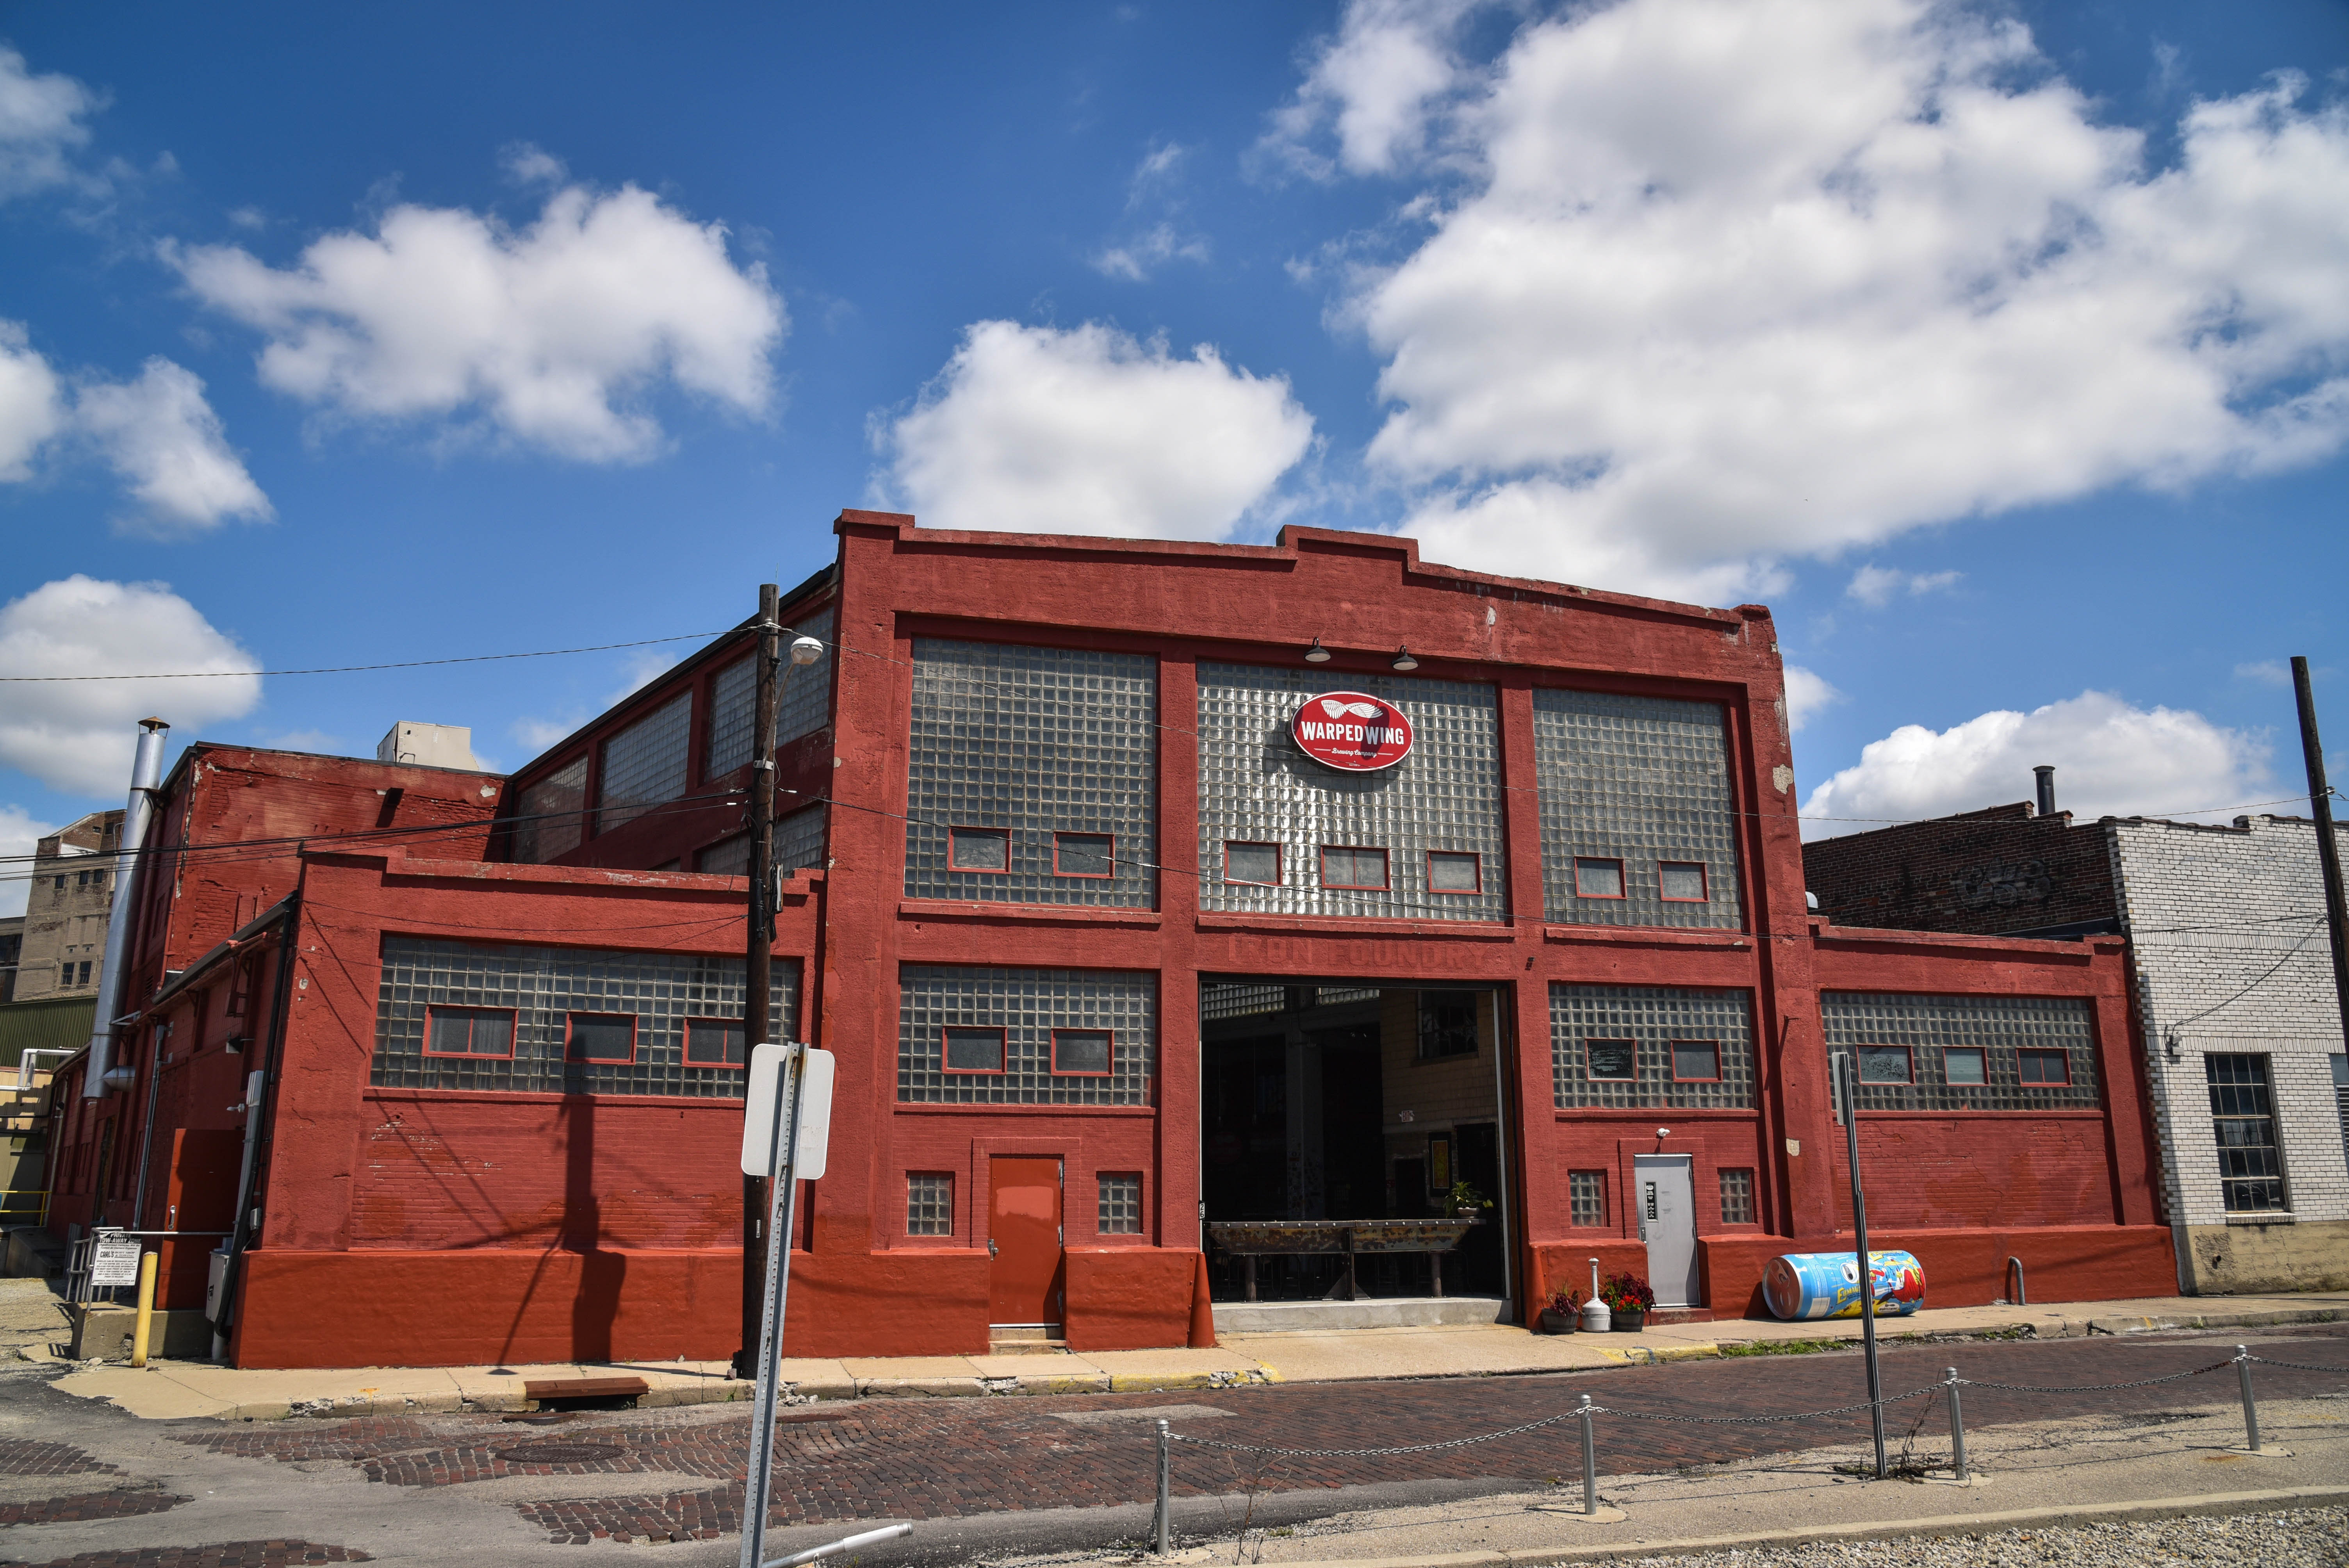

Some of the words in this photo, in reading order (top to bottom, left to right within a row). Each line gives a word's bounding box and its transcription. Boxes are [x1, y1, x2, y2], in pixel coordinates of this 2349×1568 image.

[1331, 747, 1354, 756] Brewing
[1354, 749, 1377, 758] Company
[1228, 936, 1313, 964] IRON
[1328, 940, 1490, 970] FOUNDRY
[1200, 1204, 1204, 1217] 26
